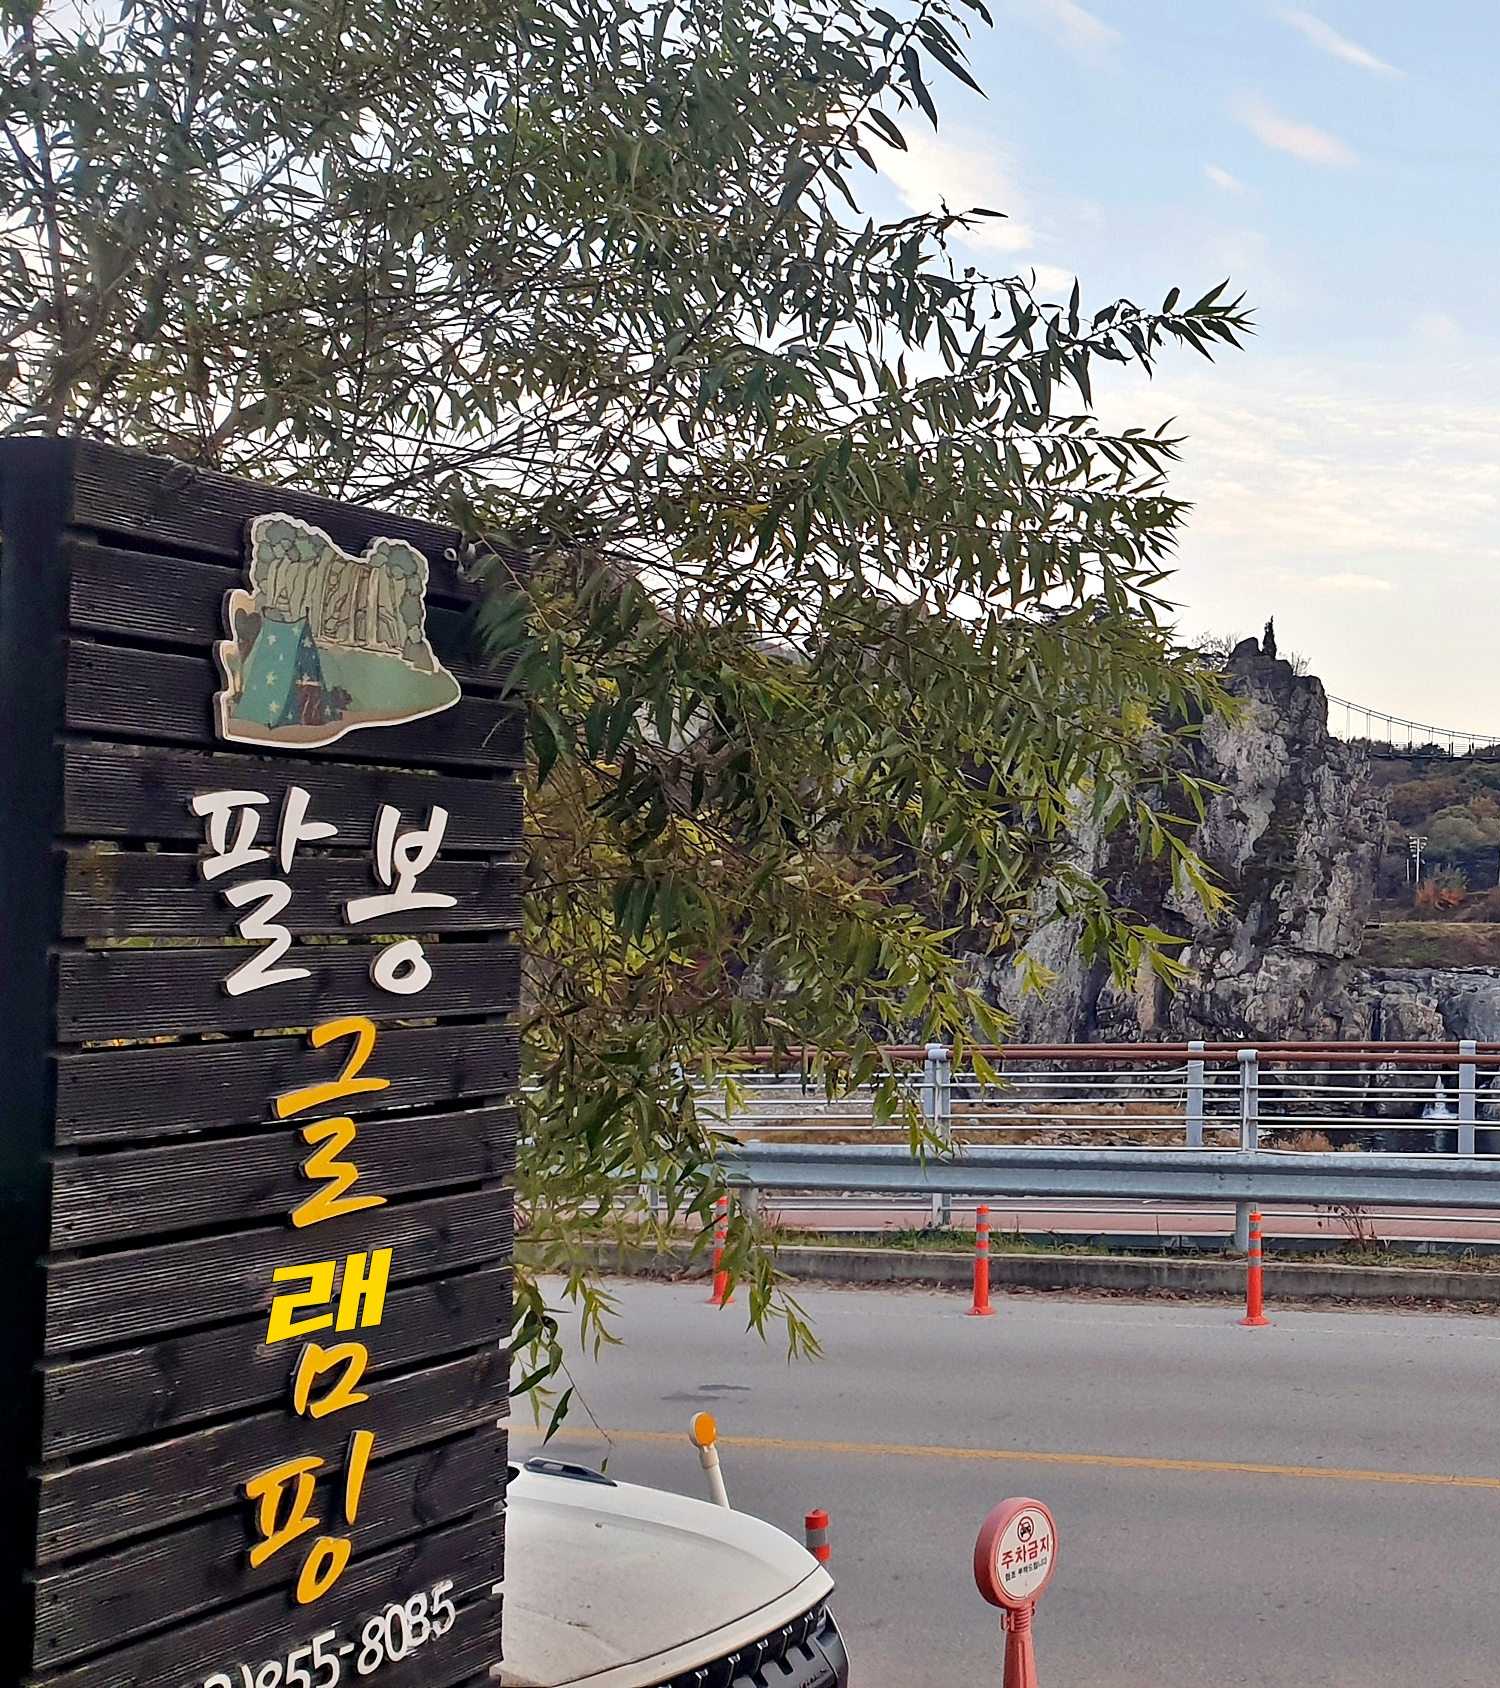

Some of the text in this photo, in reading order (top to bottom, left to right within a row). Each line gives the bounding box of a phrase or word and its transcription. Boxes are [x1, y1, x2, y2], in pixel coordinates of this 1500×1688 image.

[192, 786, 458, 996] 팔봉
[246, 1016, 393, 1604] 글램핑
[1001, 1534, 1049, 1569] 주차금지
[204, 1580, 456, 1688] 55-8085
